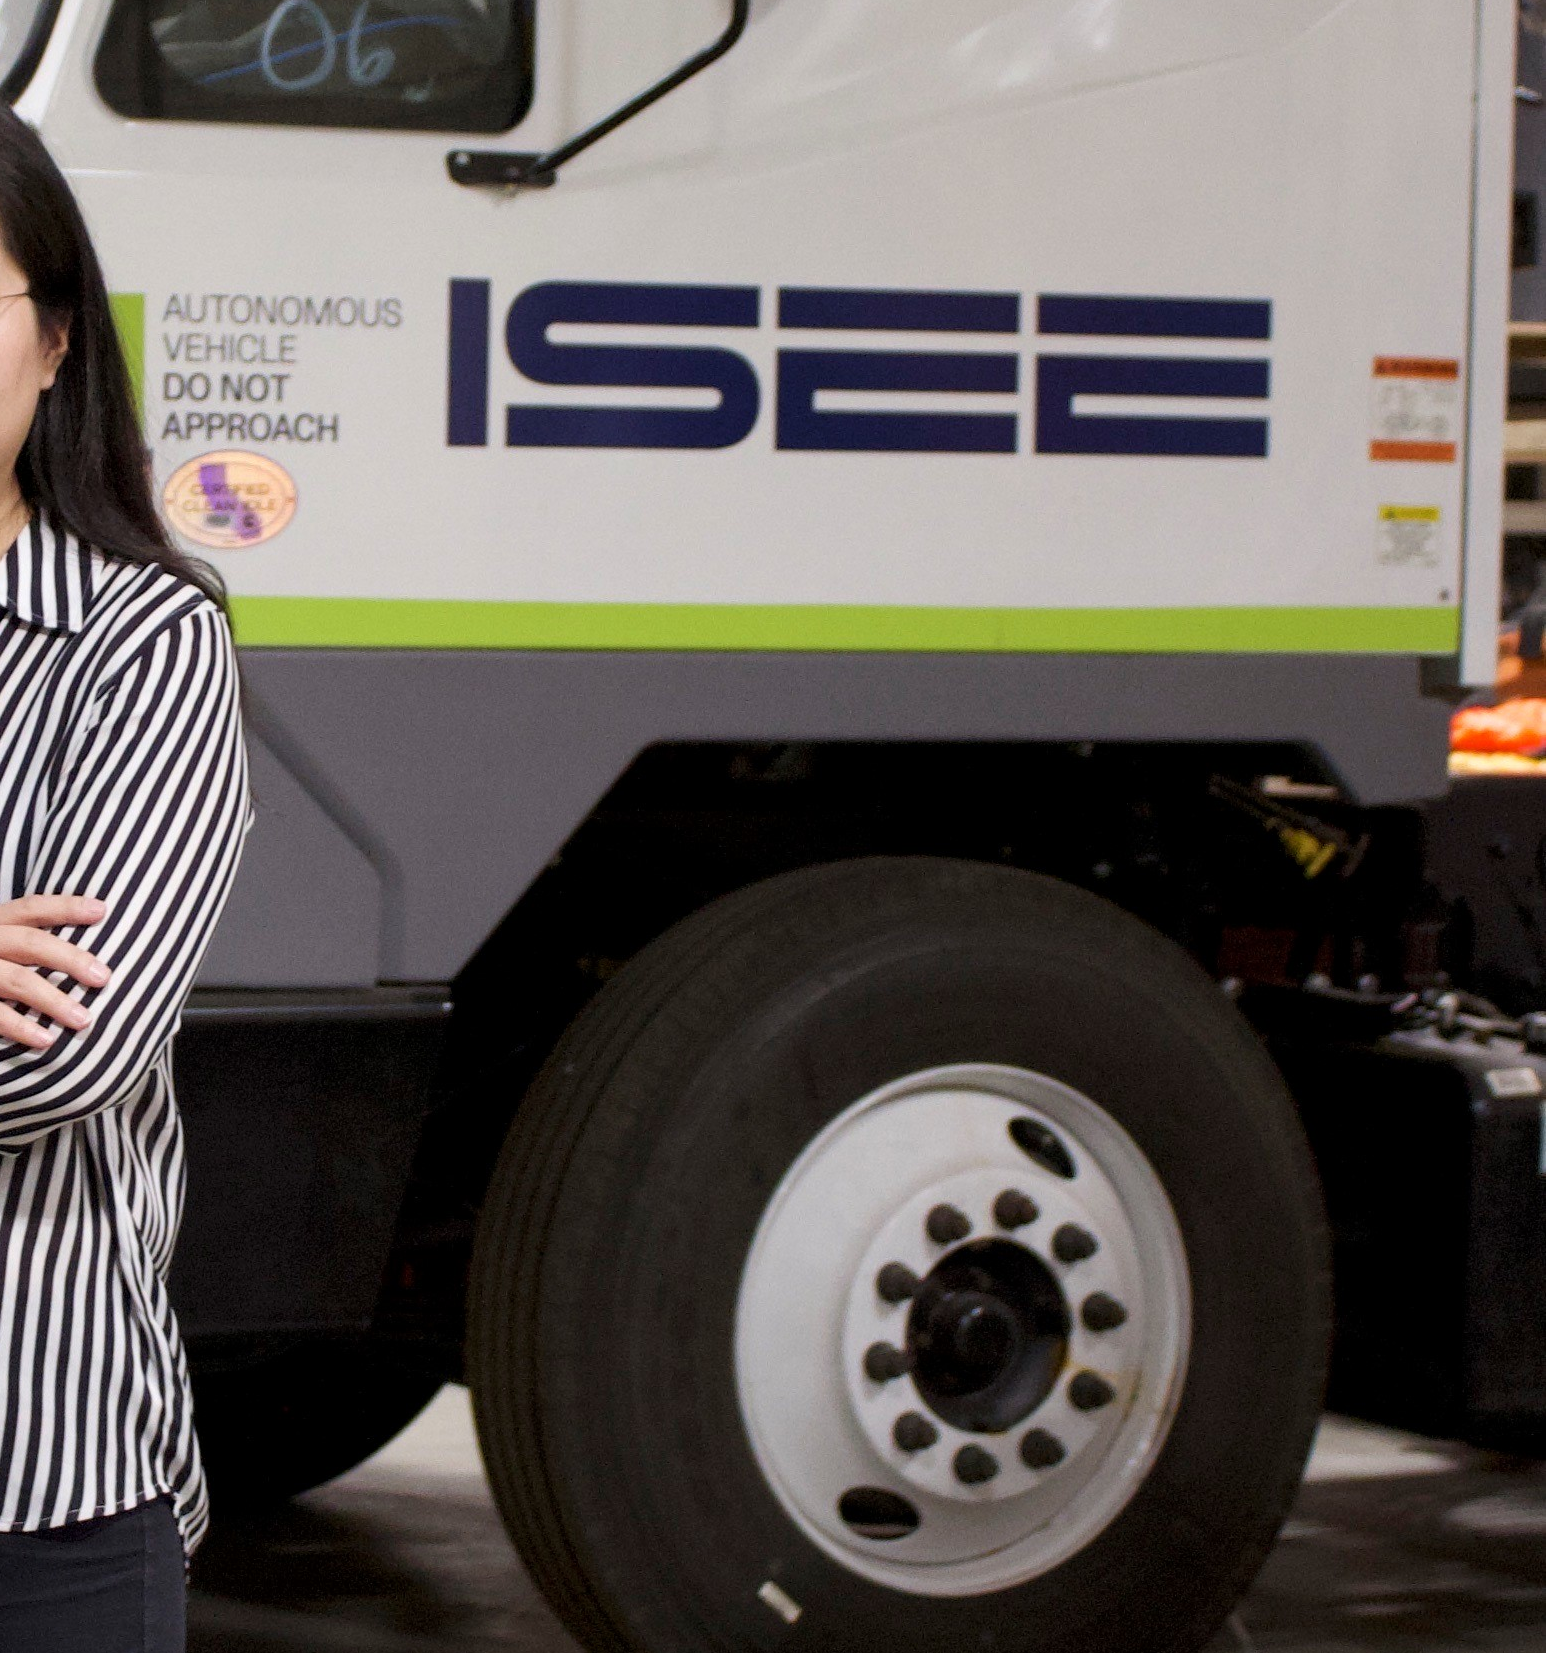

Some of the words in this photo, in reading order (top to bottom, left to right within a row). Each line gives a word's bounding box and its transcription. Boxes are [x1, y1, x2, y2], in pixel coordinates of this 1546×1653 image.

[163, 294, 401, 328] AUTONOMOUS
[163, 332, 296, 364] VEHICLE
[447, 278, 1273, 457] ISEE
[163, 372, 212, 403] DO
[220, 373, 291, 403] NOT
[160, 411, 340, 443] APPROACH
